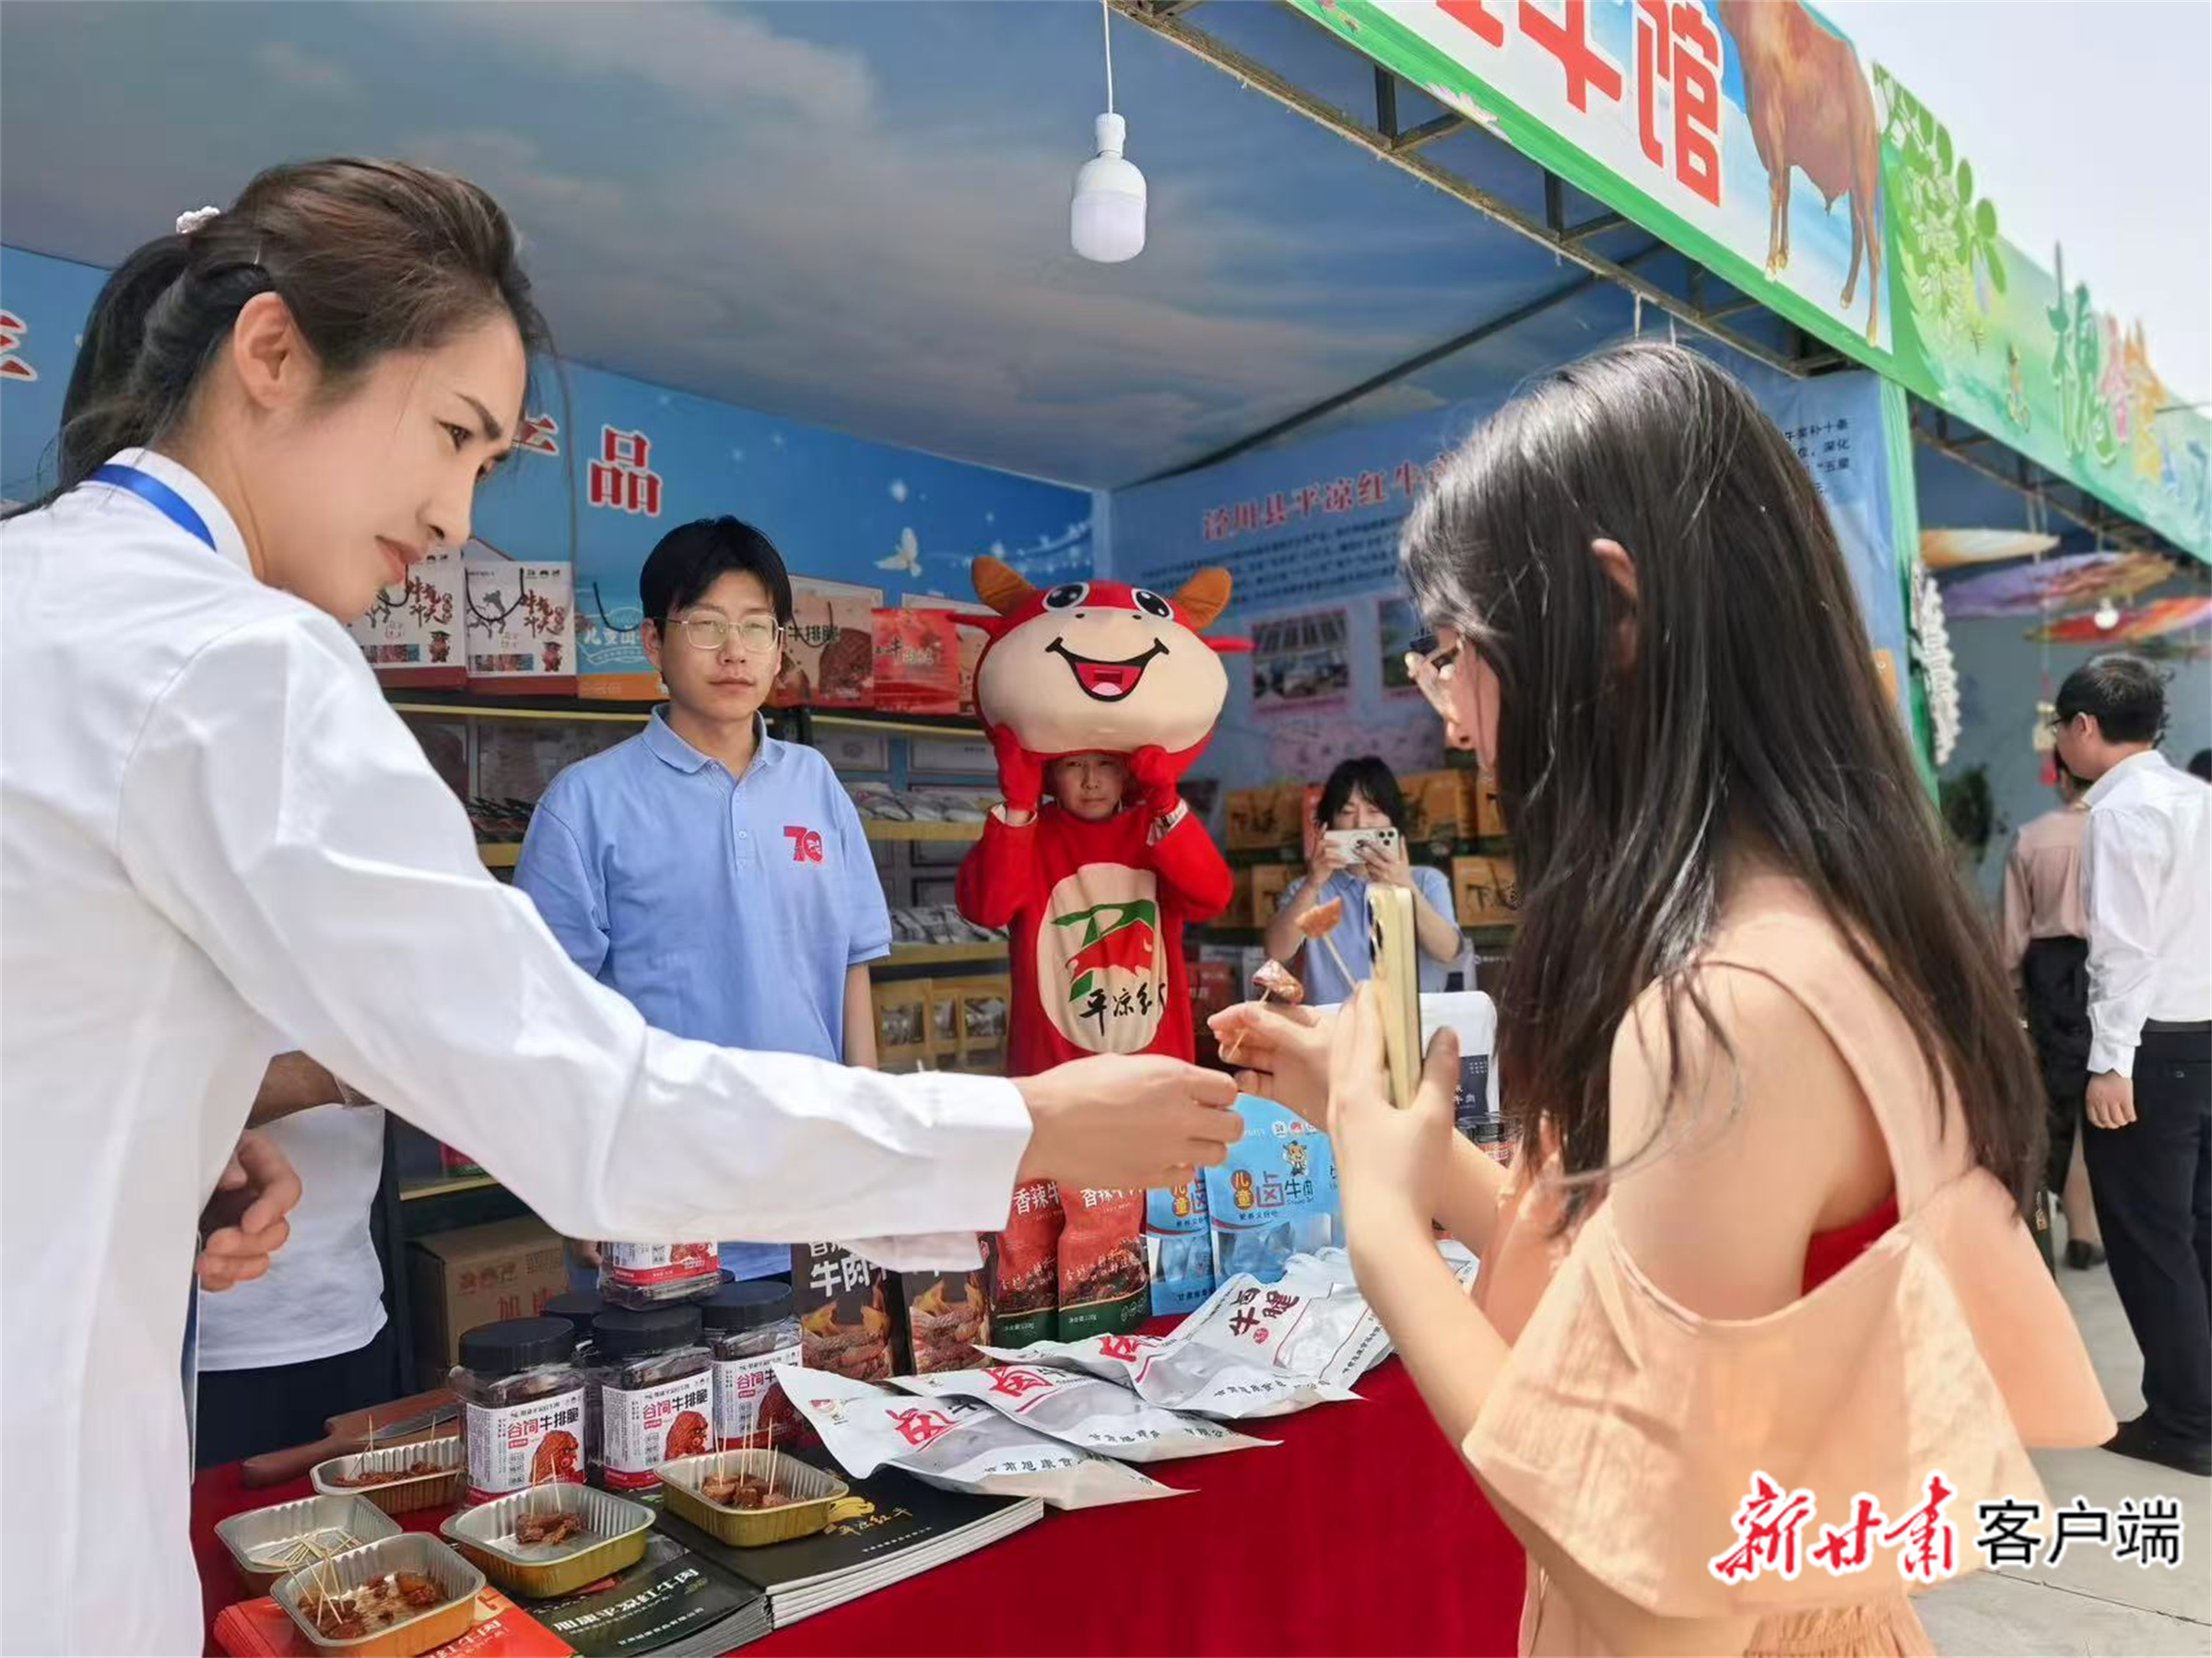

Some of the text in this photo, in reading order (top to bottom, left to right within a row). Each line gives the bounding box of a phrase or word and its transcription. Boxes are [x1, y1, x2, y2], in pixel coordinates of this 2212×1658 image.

[643, 1389, 708, 1420] 谷饲牛排脆
[508, 1407, 579, 1439] 谷饲牛排脆
